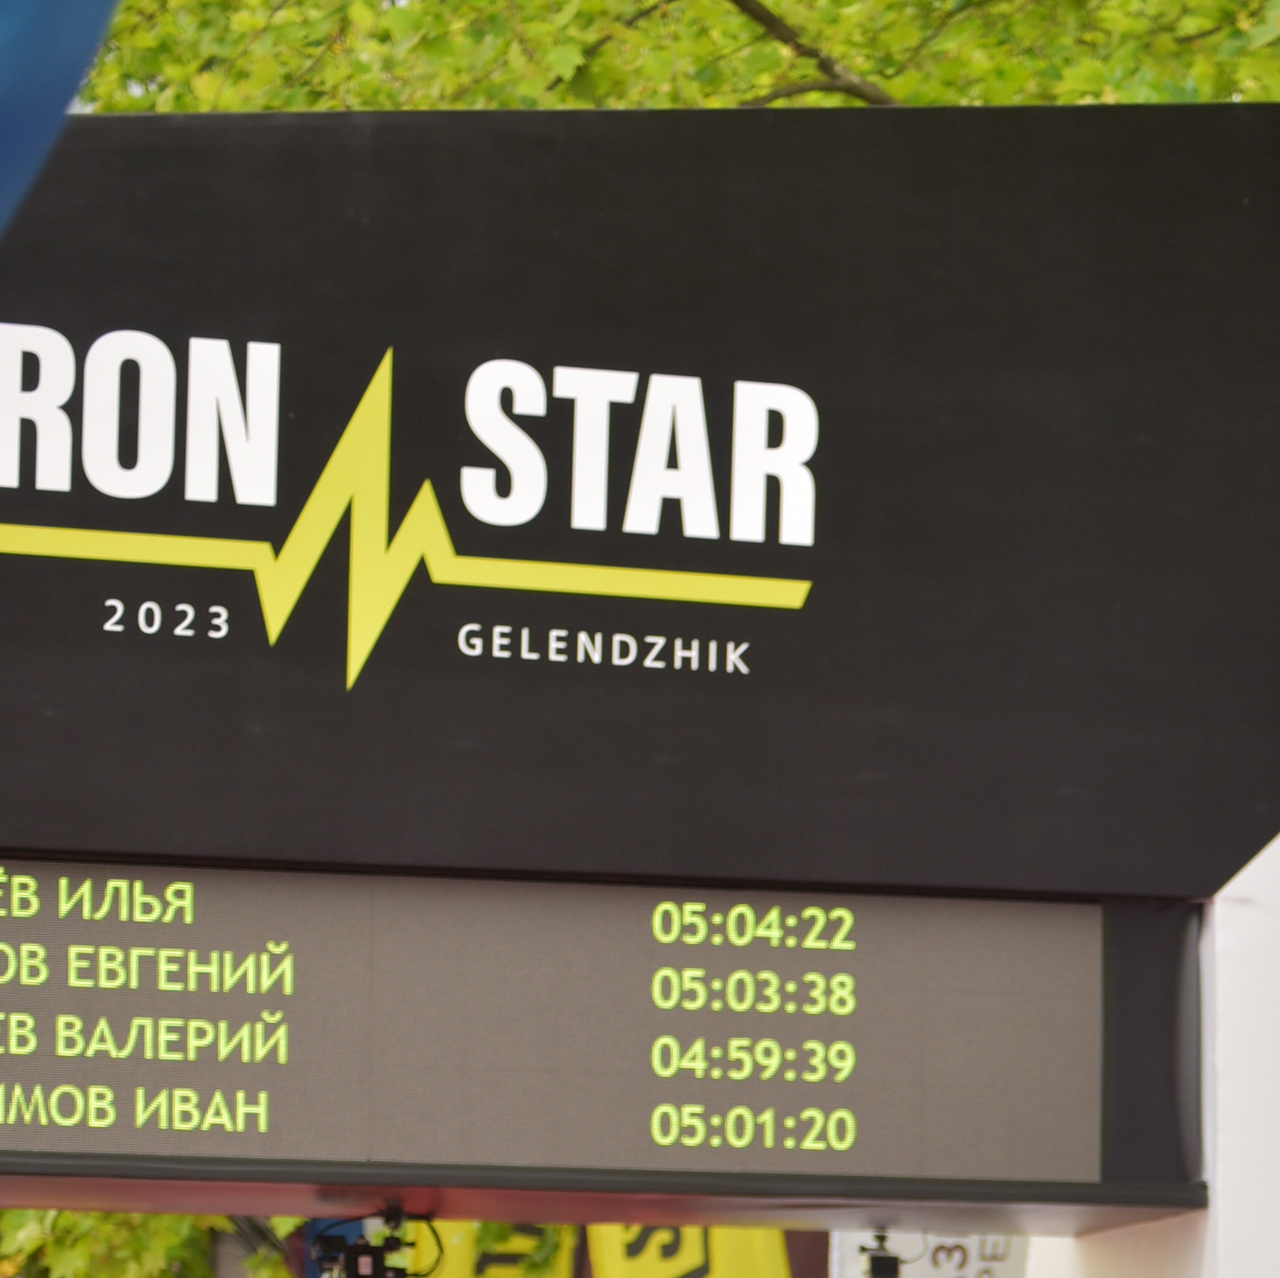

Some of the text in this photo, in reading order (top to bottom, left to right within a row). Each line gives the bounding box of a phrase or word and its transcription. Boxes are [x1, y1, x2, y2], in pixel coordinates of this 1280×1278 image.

[460, 359, 819, 547] STAR
[102, 598, 230, 639] 2023
[457, 622, 751, 675] GELENDZHIK
[57, 876, 195, 925] ИЛЬЯ
[650, 900, 857, 952] 05:04:22
[66, 940, 294, 996] ЕВГЕНИЙ
[650, 966, 857, 1017] 05:03:38
[54, 1009, 289, 1065] ВАЛЕРИЙ
[650, 1034, 857, 1084] 04:59:39
[0, 1082, 269, 1133] МОВ ИВАН
[649, 1102, 857, 1153] 05:01:20
